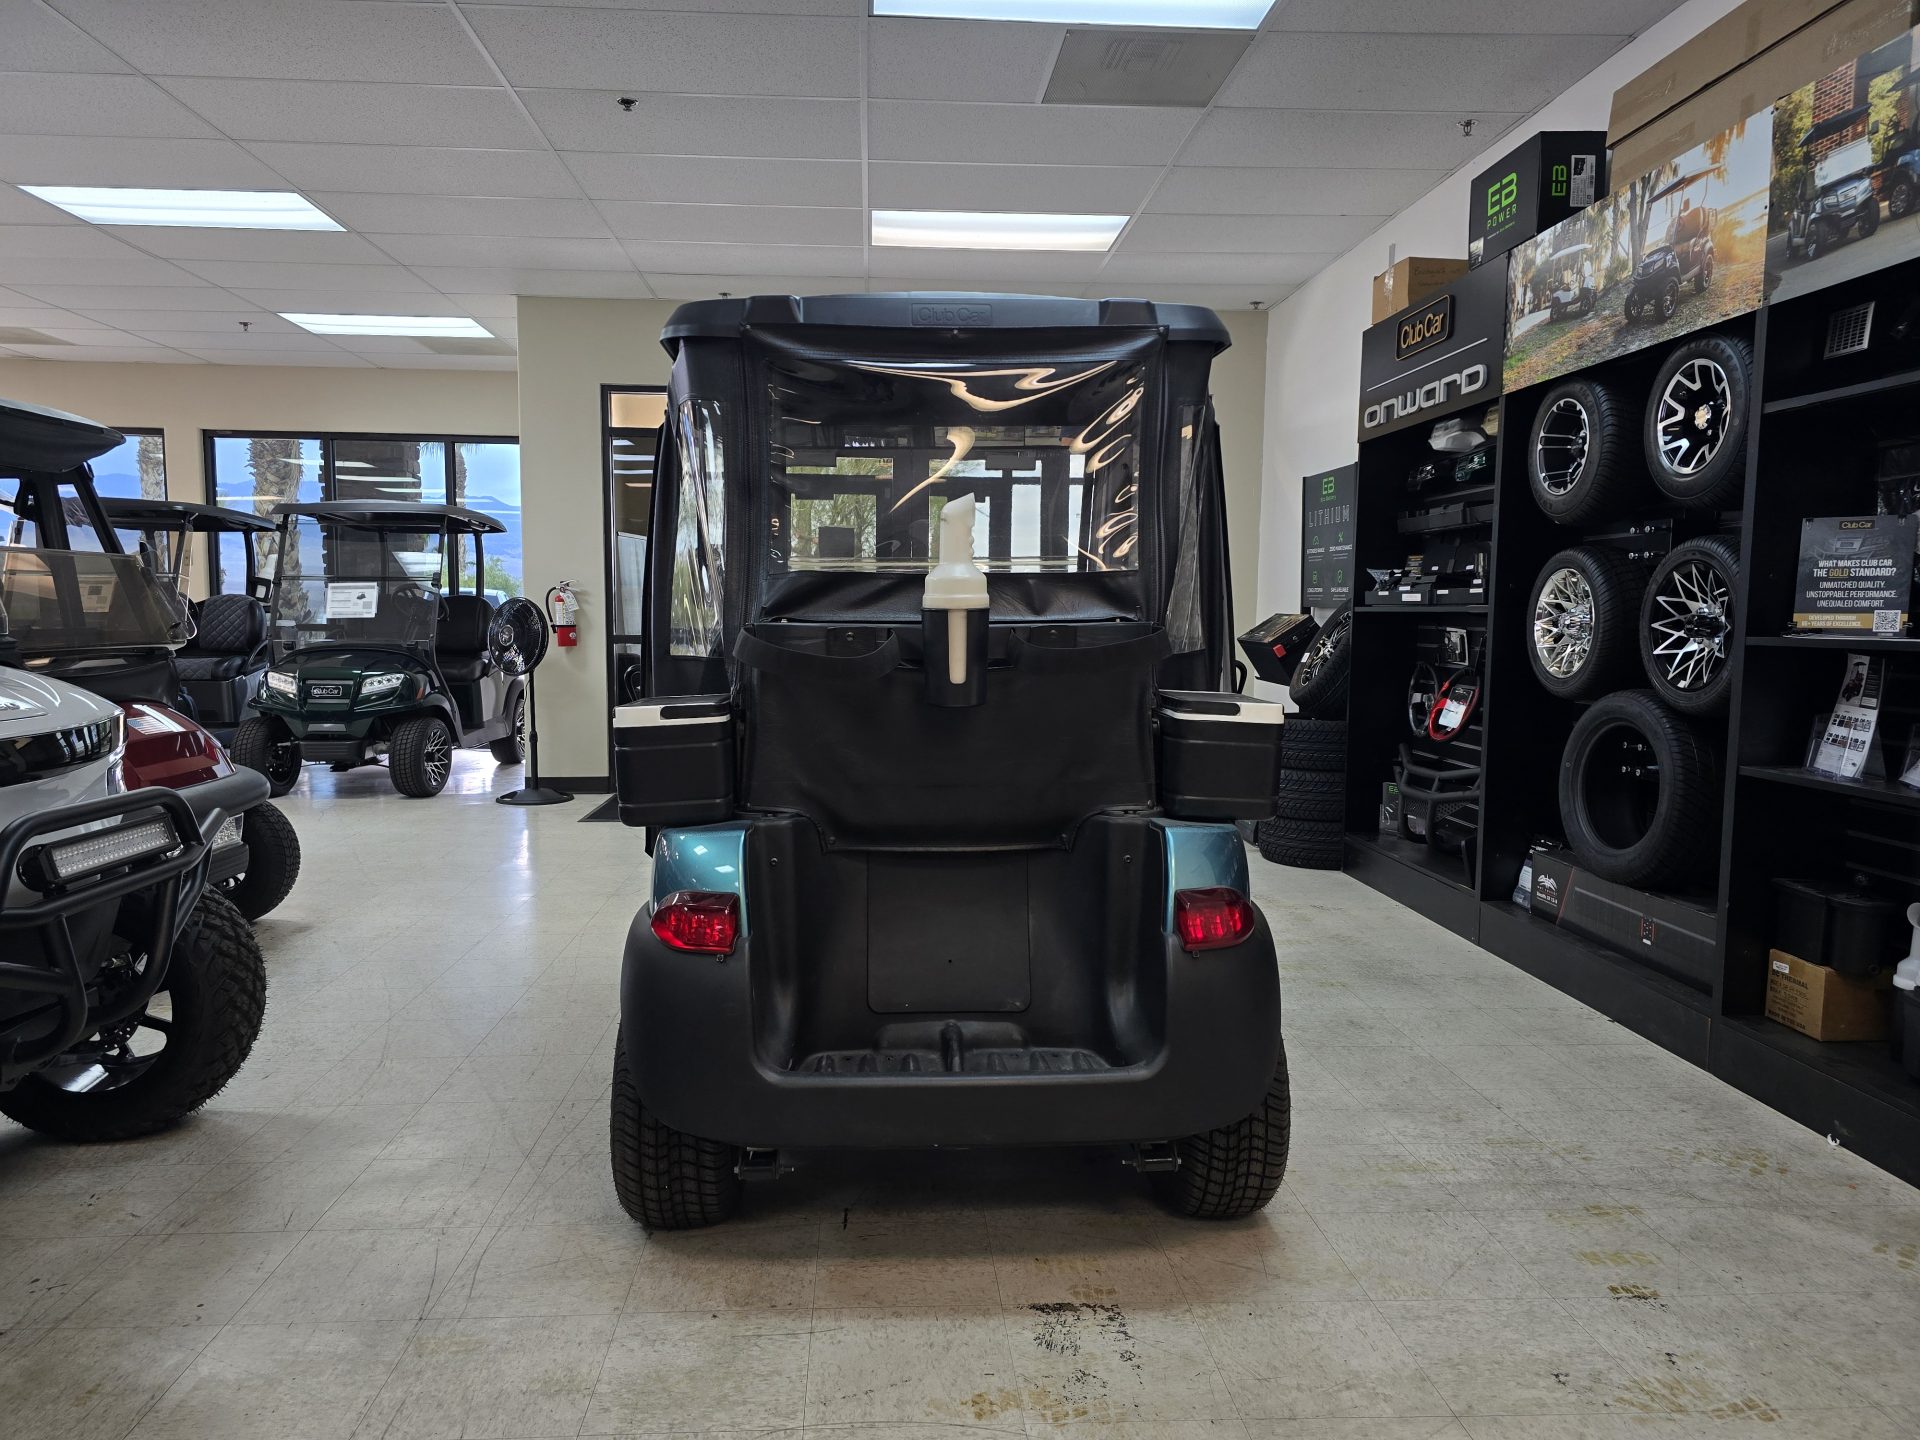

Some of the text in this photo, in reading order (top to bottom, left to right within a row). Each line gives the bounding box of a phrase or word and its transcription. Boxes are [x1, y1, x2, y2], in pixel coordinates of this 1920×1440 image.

[1551, 165, 1567, 196] EB
[1487, 172, 1518, 217] EB
[1487, 204, 1517, 230] POWER
[918, 306, 986, 321] Club Car
[1401, 312, 1444, 349] Club Car
[1308, 504, 1350, 528] LITHIUM
[1841, 521, 1858, 529] Club
[1837, 559, 1860, 567] MAKES
[1861, 559, 1878, 567] CLUB
[1813, 567, 1897, 577] THE GOLD STANDARD?
[1819, 580, 1886, 589] UNMATCHED QUALITY.
[1806, 590, 1898, 598] UNSTOPPABLE PERFORMANCE.
[1853, 599, 1885, 607] COMFORT.
[328, 687, 339, 695] Car
